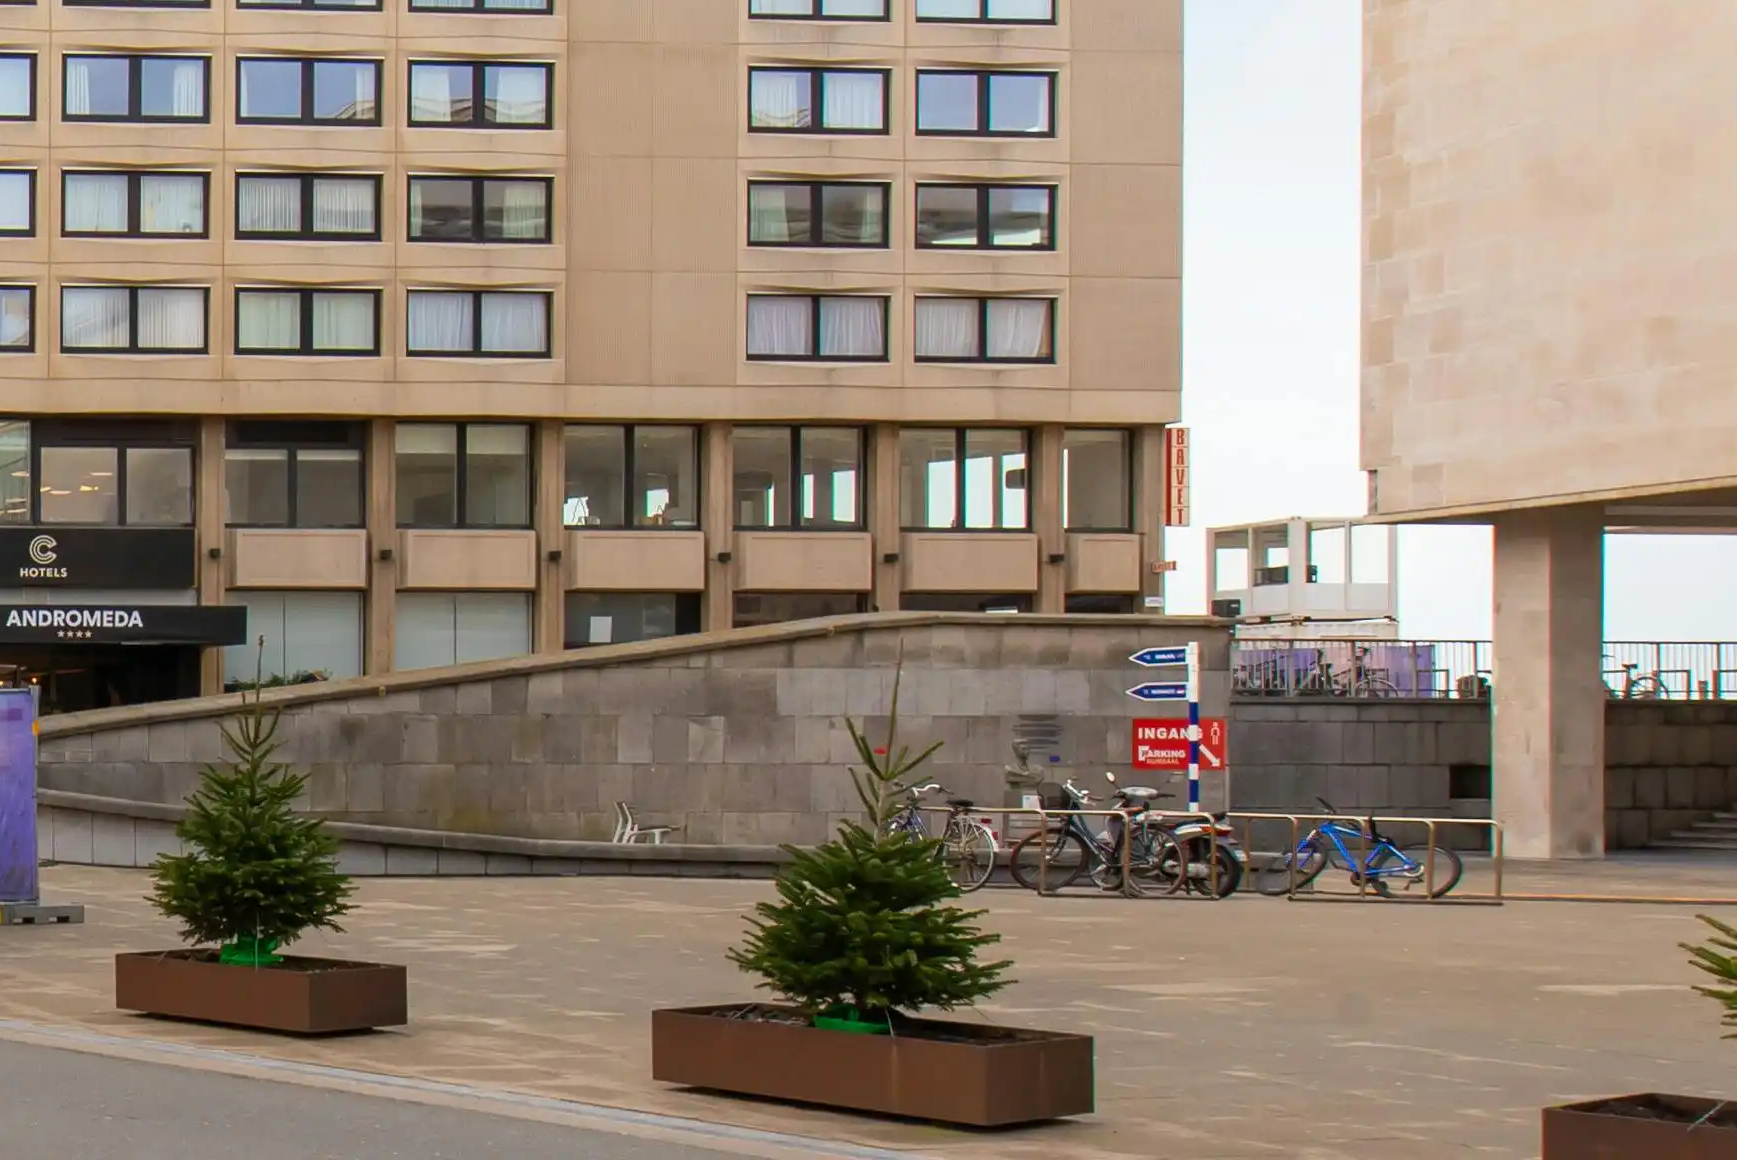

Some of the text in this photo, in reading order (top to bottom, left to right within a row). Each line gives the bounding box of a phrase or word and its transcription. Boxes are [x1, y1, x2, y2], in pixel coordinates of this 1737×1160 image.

[1176, 428, 1185, 525] BAVET
[20, 567, 68, 578] HOTELS
[6, 610, 144, 628] ANDROMEDA
